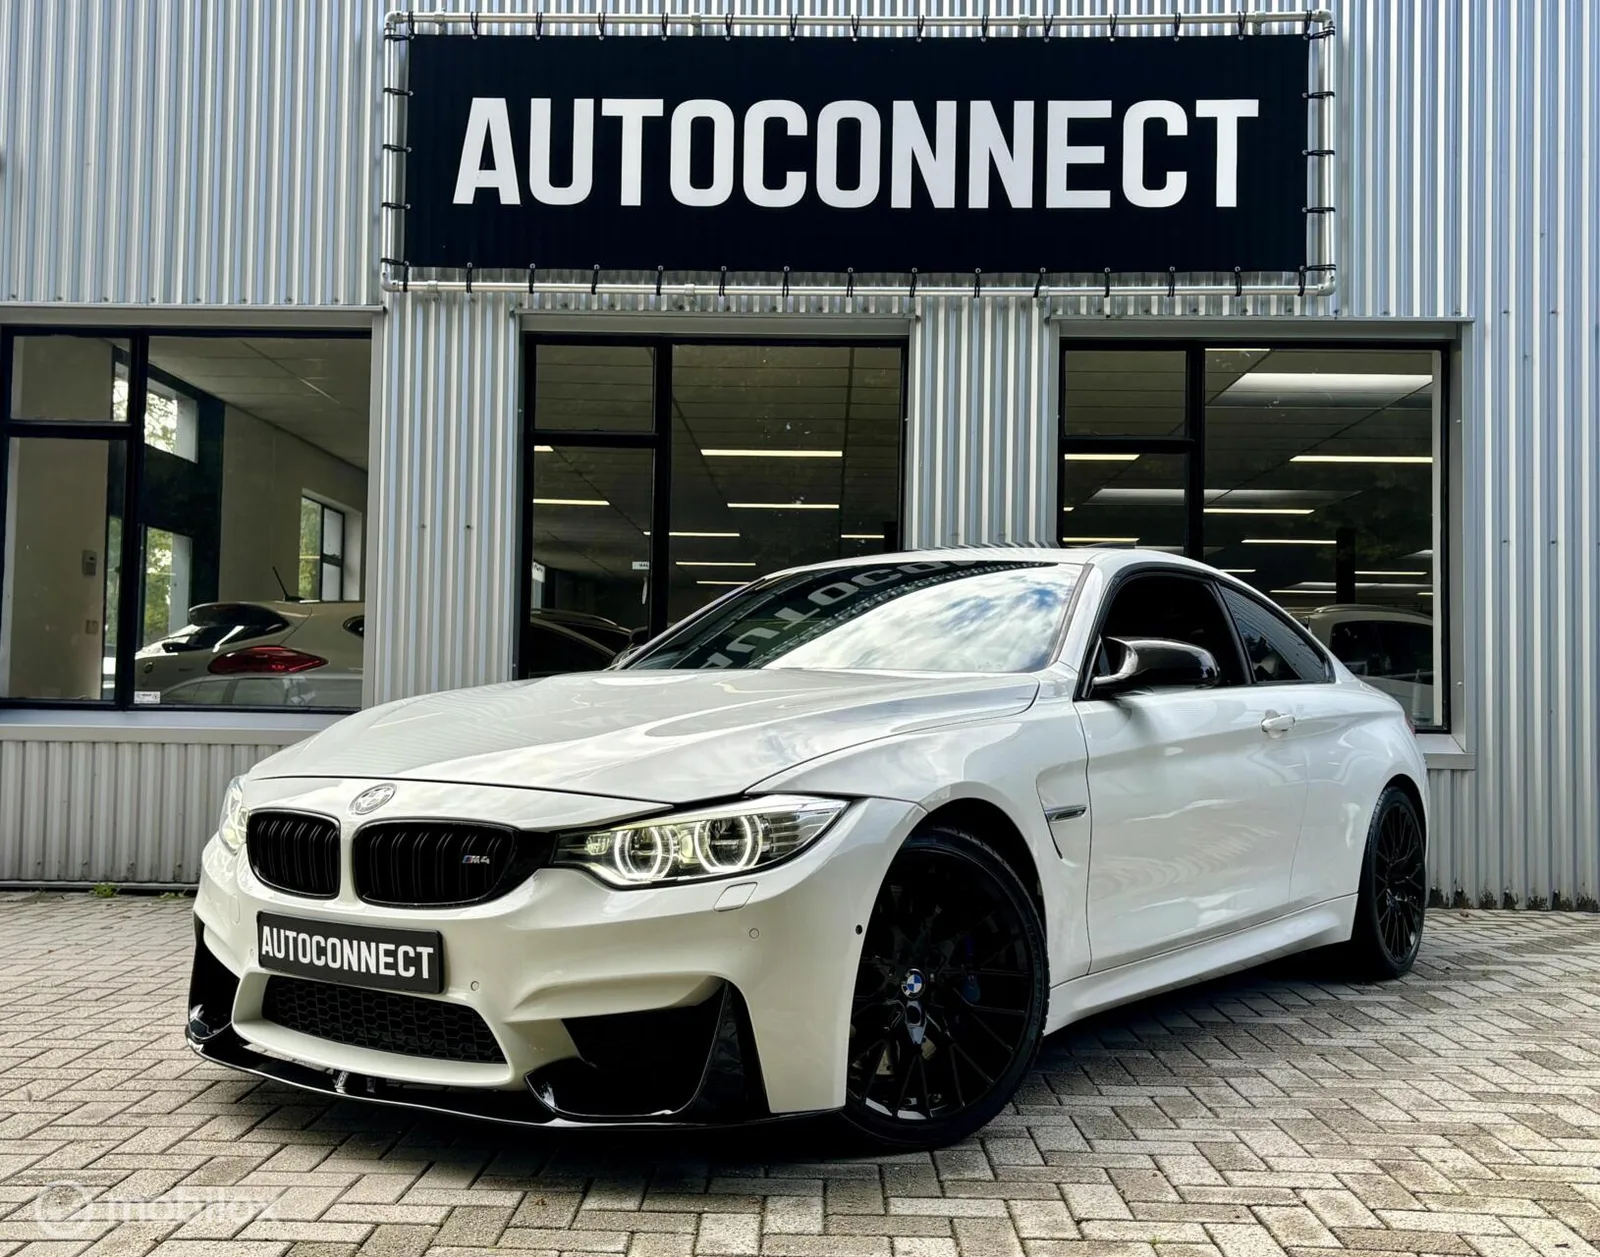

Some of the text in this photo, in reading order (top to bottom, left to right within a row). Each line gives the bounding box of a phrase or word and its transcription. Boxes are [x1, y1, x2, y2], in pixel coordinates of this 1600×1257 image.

[453, 97, 1258, 209] AUTOCONNECT
[470, 855, 490, 864] M4
[261, 925, 434, 979] AUTOCONNECT
